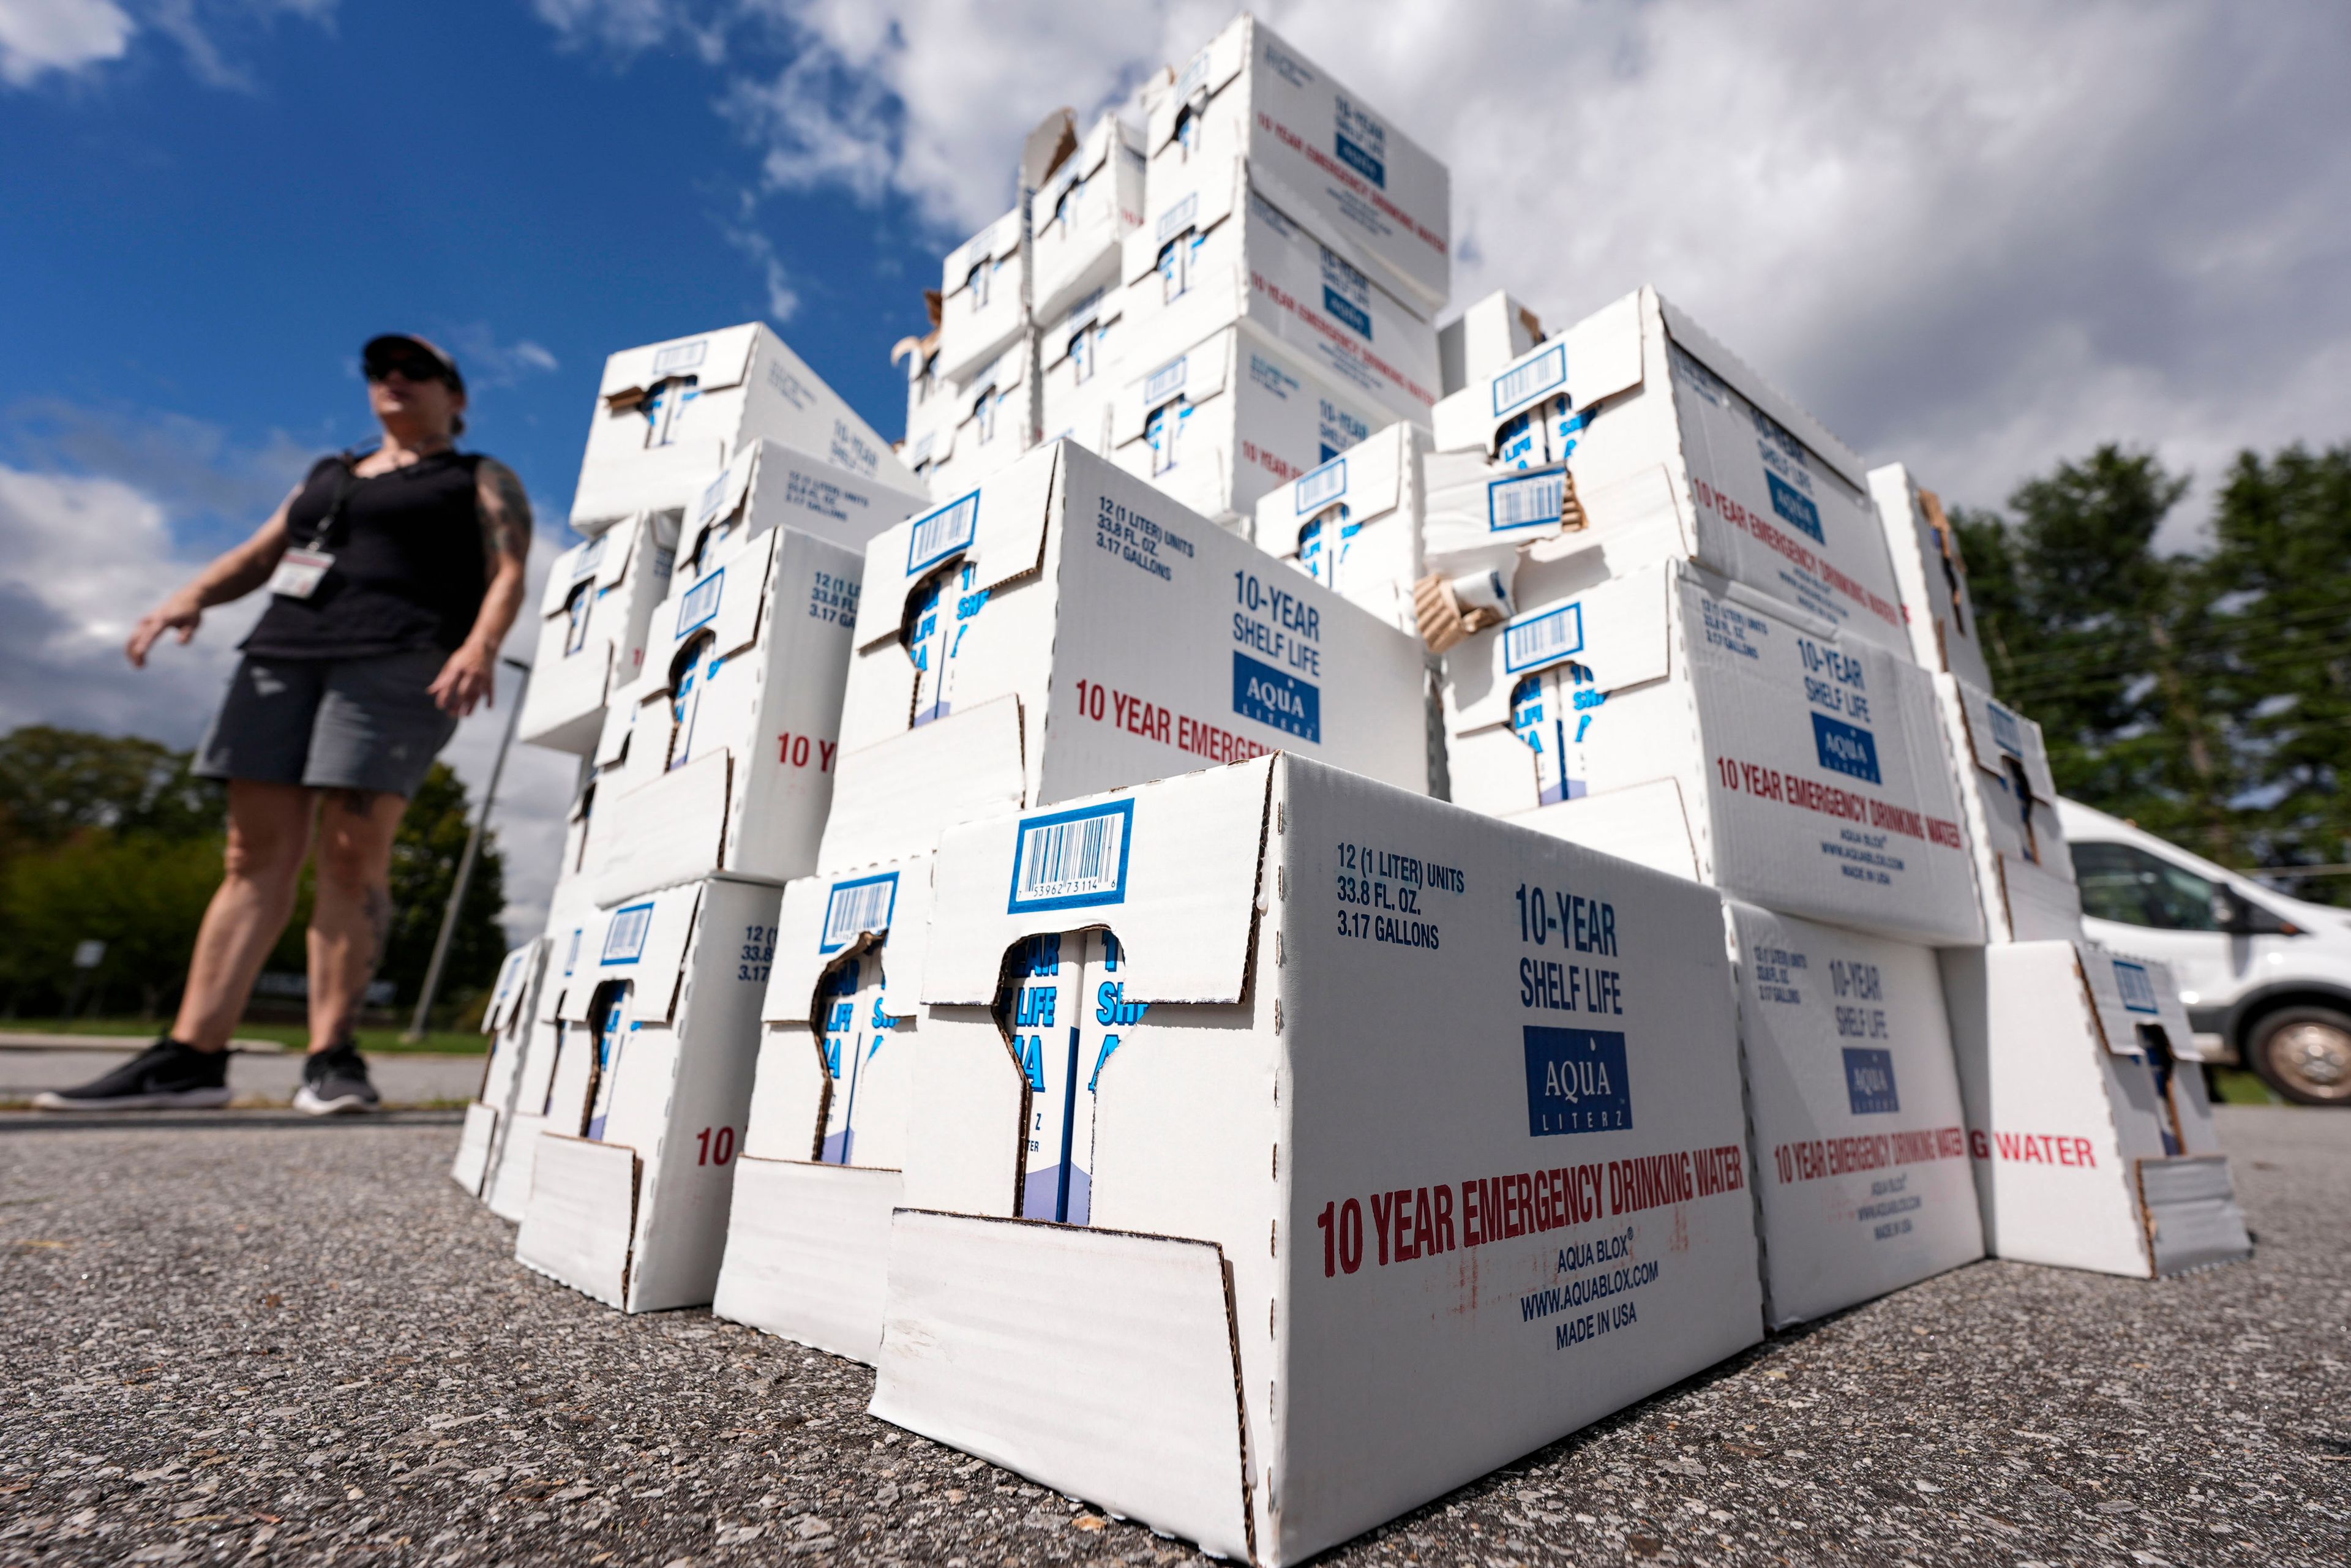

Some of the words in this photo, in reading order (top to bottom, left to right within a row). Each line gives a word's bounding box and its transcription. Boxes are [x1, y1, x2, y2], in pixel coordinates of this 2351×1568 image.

[1097, 514, 1122, 538] 33.8
[1123, 527, 1139, 547] FL.
[1142, 538, 1159, 558] OZ.
[1099, 496, 1113, 515] 12
[1116, 505, 1126, 522] (1
[1128, 512, 1163, 544] LITER)
[1164, 528, 1195, 559] UNITS
[816, 571, 831, 588] 12
[1095, 531, 1121, 556] 3.17
[1122, 546, 1172, 582] GALLONS
[1234, 568, 1320, 643] 10-YEAR
[1232, 611, 1284, 659] SHELF
[1289, 638, 1320, 677] LIFE
[1796, 637, 1866, 691] 10-YEAR
[1076, 678, 1106, 721] 10
[1112, 689, 1172, 745] YEAR
[1803, 674, 1842, 712] SHELF
[778, 732, 809, 767] 10
[1717, 757, 1739, 791] 10
[1740, 762, 1783, 803] YEAR
[1784, 773, 1868, 824] EMERGENCY
[1337, 842, 1356, 870] 12
[1360, 847, 1373, 878] (1
[1379, 852, 1423, 891] LITER)
[1427, 862, 1465, 893] UNITS
[1337, 875, 1370, 906] 33.8
[1374, 882, 1395, 911] FL.
[1399, 888, 1422, 916] OZ.
[746, 925, 764, 942] 12
[1337, 910, 1371, 940] 3.17
[1374, 915, 1440, 950] GALLONS
[1515, 883, 1618, 958] 10-YEAR
[738, 964, 771, 982] 3.17
[1519, 957, 1581, 1012] SHELF
[1584, 967, 1623, 1015] LIFE
[1014, 986, 1058, 1028] LIFE
[1544, 1060, 1612, 1103] AQUA
[1542, 1110, 1623, 1132] LITERZ
[696, 1125, 735, 1167] 10
[1774, 1143, 1793, 1185] 10
[1793, 1139, 1828, 1181] YEAR
[1826, 1134, 1892, 1176] EMERGENCY
[1969, 1129, 1989, 1161] G
[1993, 1131, 2098, 1169] WATER
[1318, 1197, 1363, 1278] 10
[1371, 1184, 1456, 1266] YEAR
[1461, 1163, 1604, 1248] EMERGENCY
[1608, 1150, 1692, 1217] DRINKING
[1692, 1144, 1744, 1198] WATER
[1557, 1247, 1595, 1274] AQUA
[1520, 1259, 1660, 1323] WWW.AQUABLOX.COM
[1555, 1313, 1595, 1351] MADE
[1597, 1308, 1610, 1335] IN
[1612, 1301, 1637, 1329] USA
